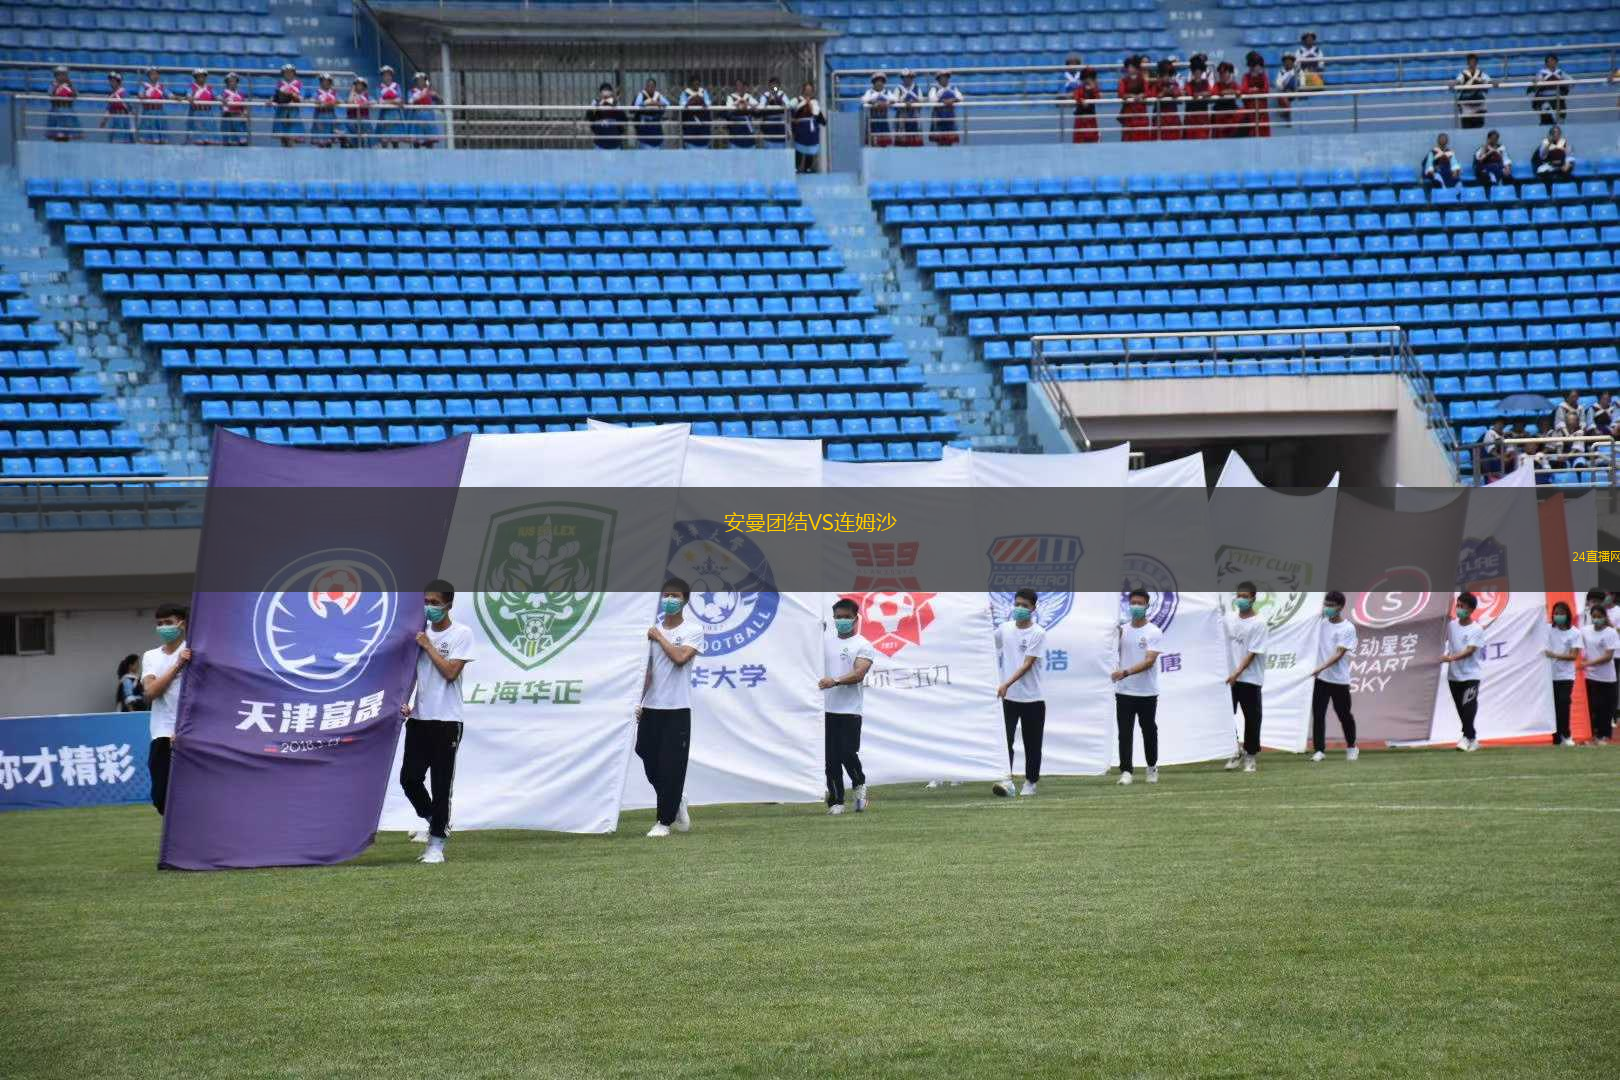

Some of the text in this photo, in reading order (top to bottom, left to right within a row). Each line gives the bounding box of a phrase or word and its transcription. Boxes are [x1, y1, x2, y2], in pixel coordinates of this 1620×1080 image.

[847, 541, 920, 567] 359
[1457, 554, 1500, 574] TURE
[1353, 632, 1419, 658] 动星空
[1348, 655, 1415, 675] MART
[463, 679, 583, 705] 上海华正
[1350, 675, 1392, 694] SKY
[234, 689, 386, 733] 天津富晟
[0, 743, 136, 790] 你才精彩
